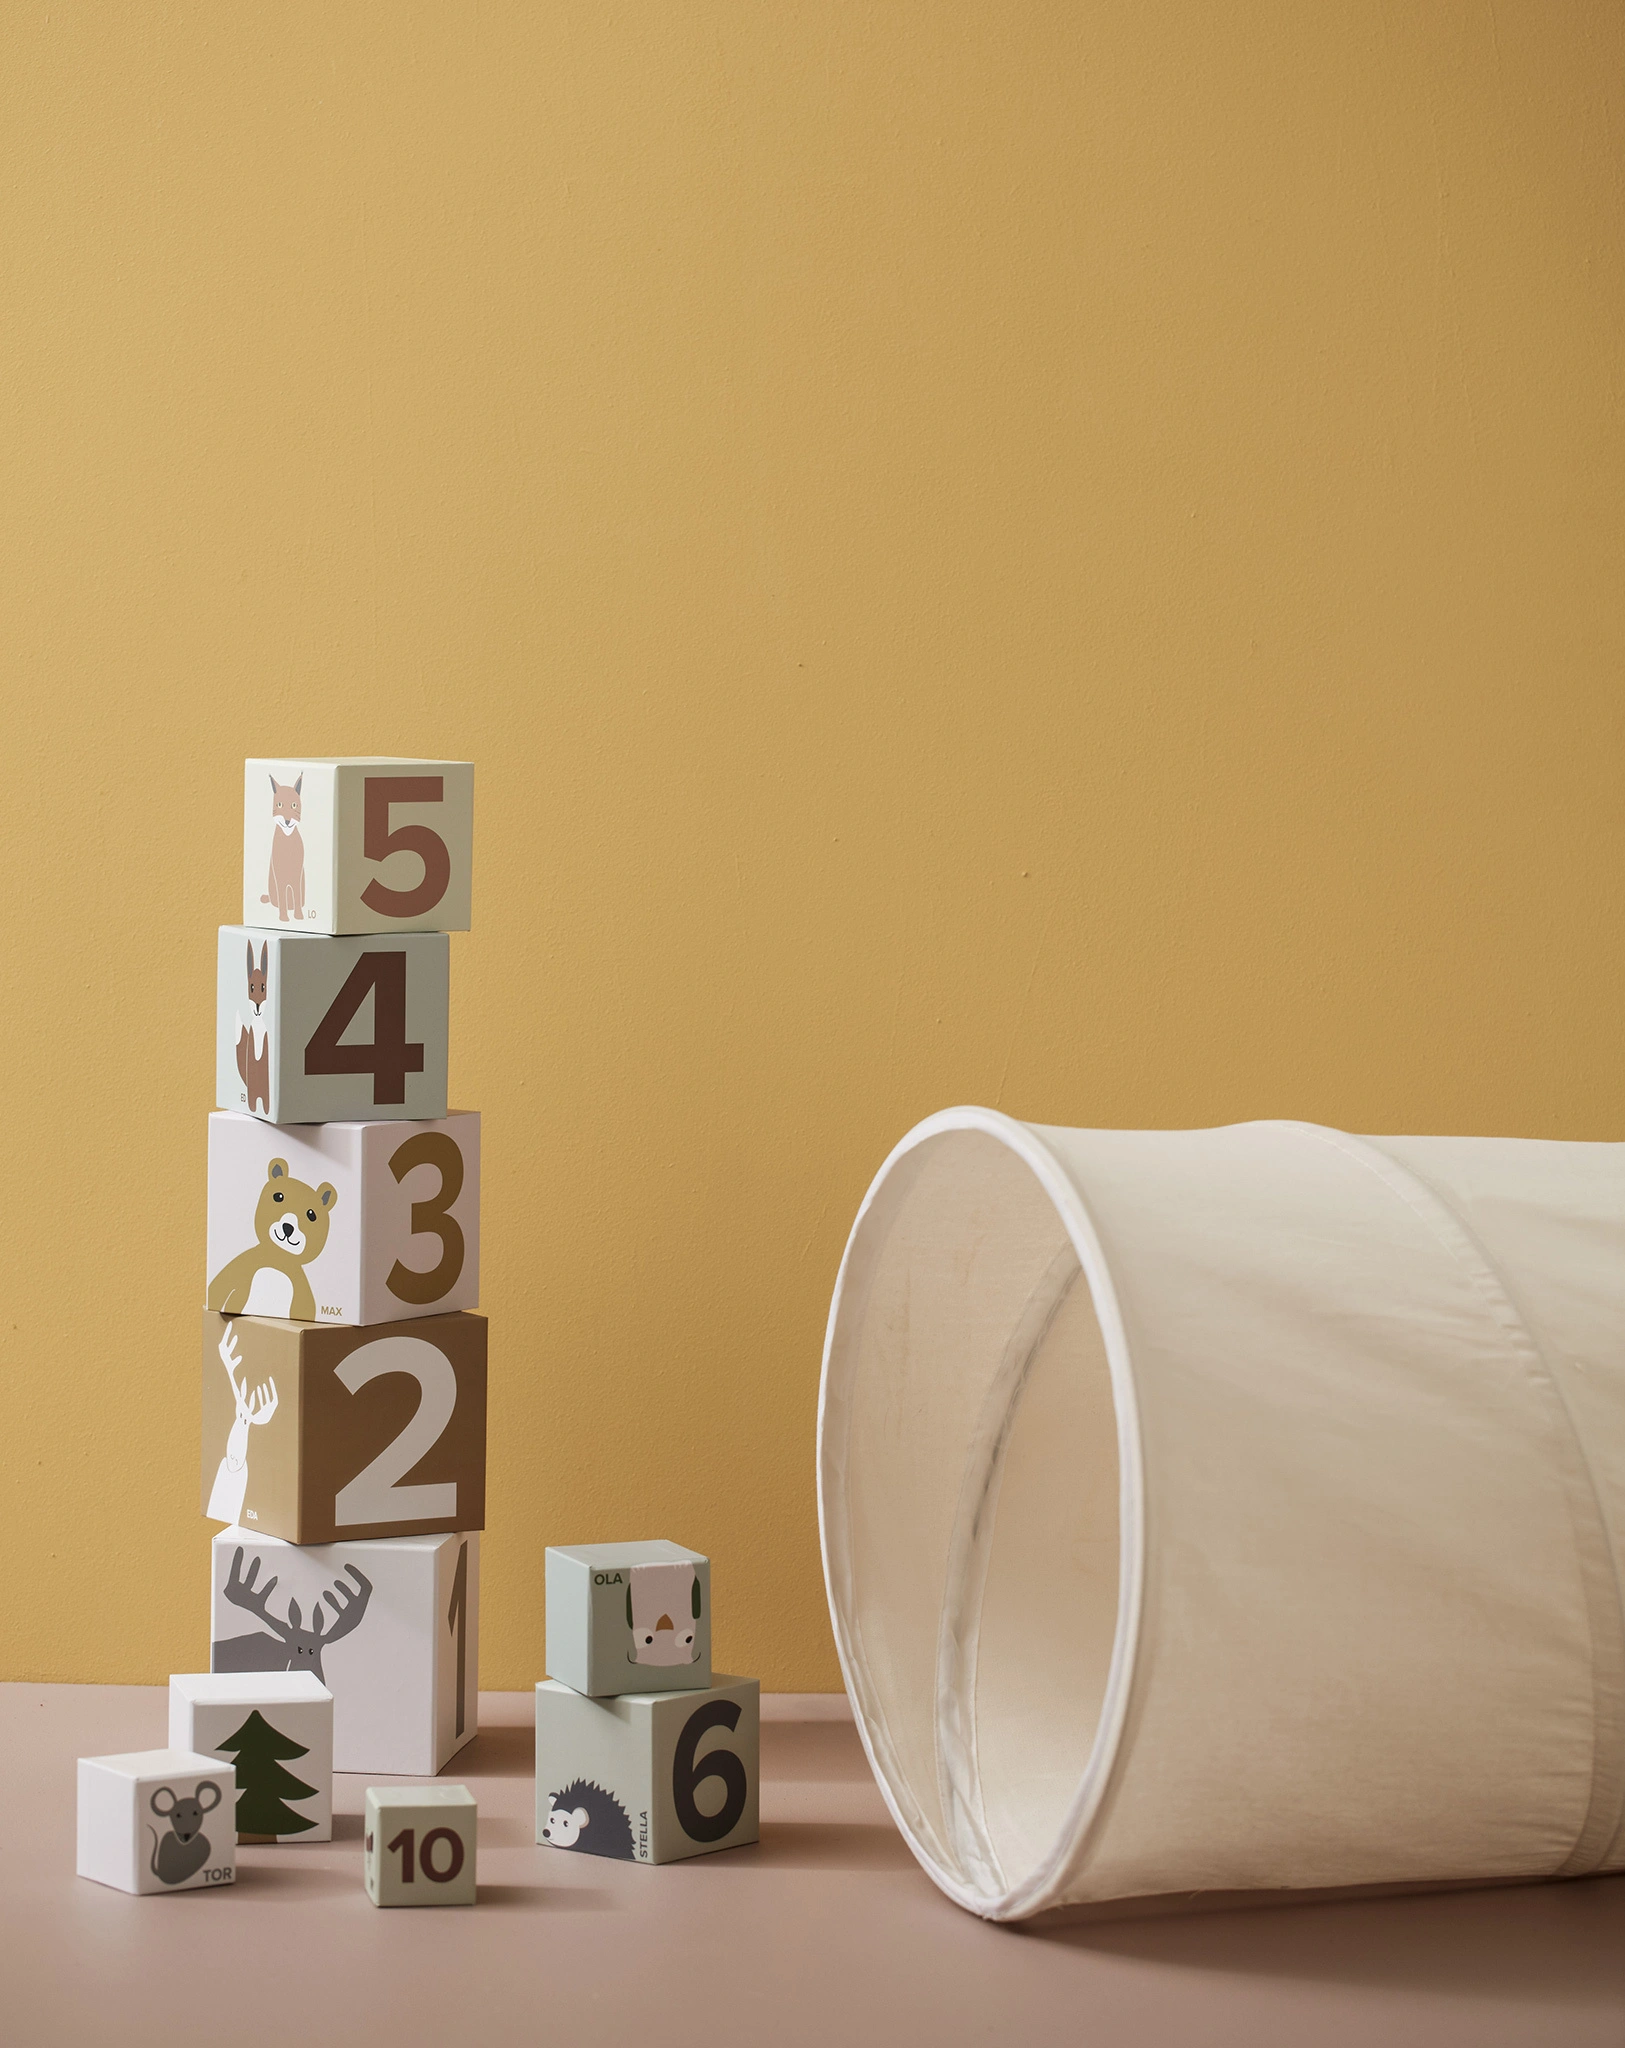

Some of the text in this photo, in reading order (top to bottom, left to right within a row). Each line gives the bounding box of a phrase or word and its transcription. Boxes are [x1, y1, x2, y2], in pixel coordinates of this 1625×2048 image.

[360, 776, 450, 918] 5
[308, 910, 316, 919] LO
[304, 951, 424, 1105] 4
[385, 1132, 465, 1304] 3
[321, 1306, 342, 1316] MAX
[333, 1336, 457, 1526] 2
[247, 1509, 258, 1520] EDA
[594, 1573, 623, 1586] OLA
[448, 1540, 468, 1739] 1
[673, 1699, 747, 1843] 6
[387, 1827, 464, 1883] 10
[640, 1811, 648, 1858] STELLA
[203, 1867, 232, 1882] TOR
